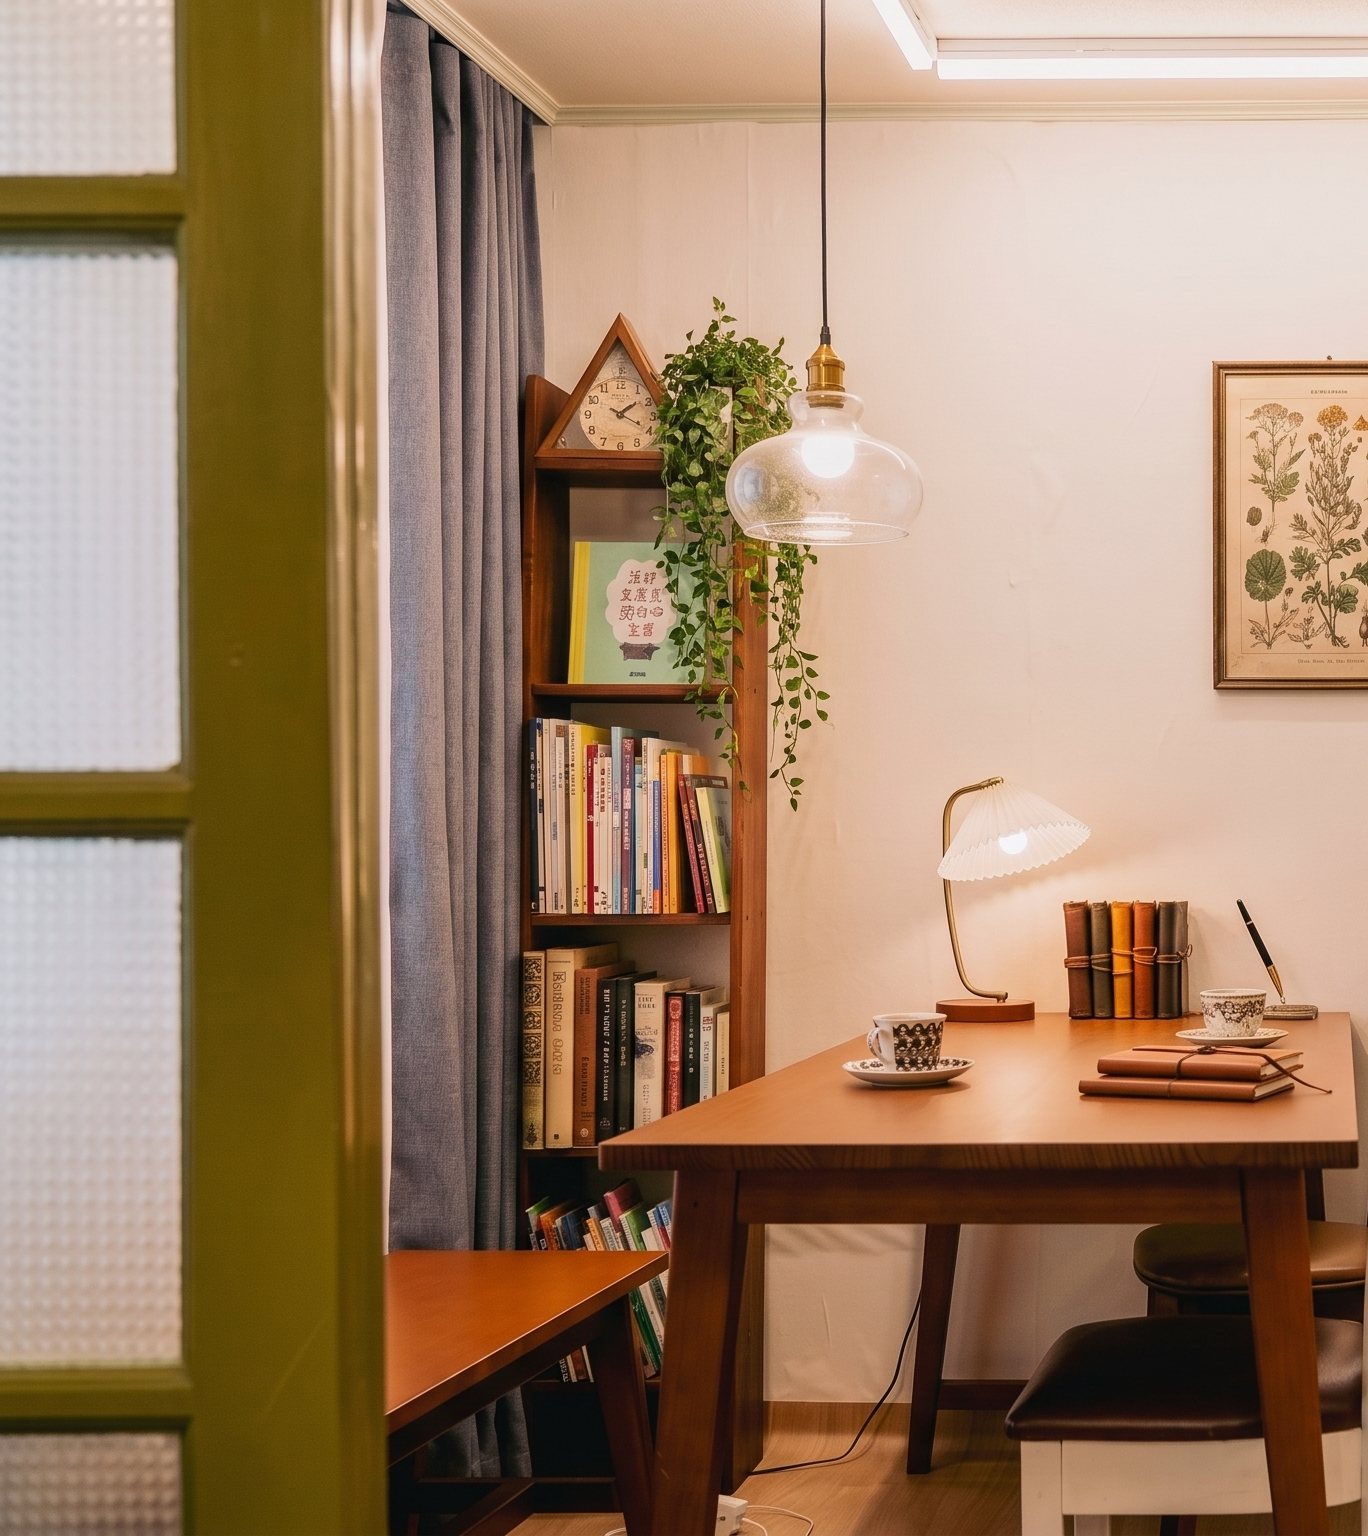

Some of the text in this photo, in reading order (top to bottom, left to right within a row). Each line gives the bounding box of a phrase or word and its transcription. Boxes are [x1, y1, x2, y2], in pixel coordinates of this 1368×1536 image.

[635, 385, 641, 394] 1
[584, 410, 592, 419] 9
[588, 425, 596, 435] 8
[645, 426, 652, 436] 4
[600, 437, 607, 447] 7
[617, 441, 624, 451] 6
